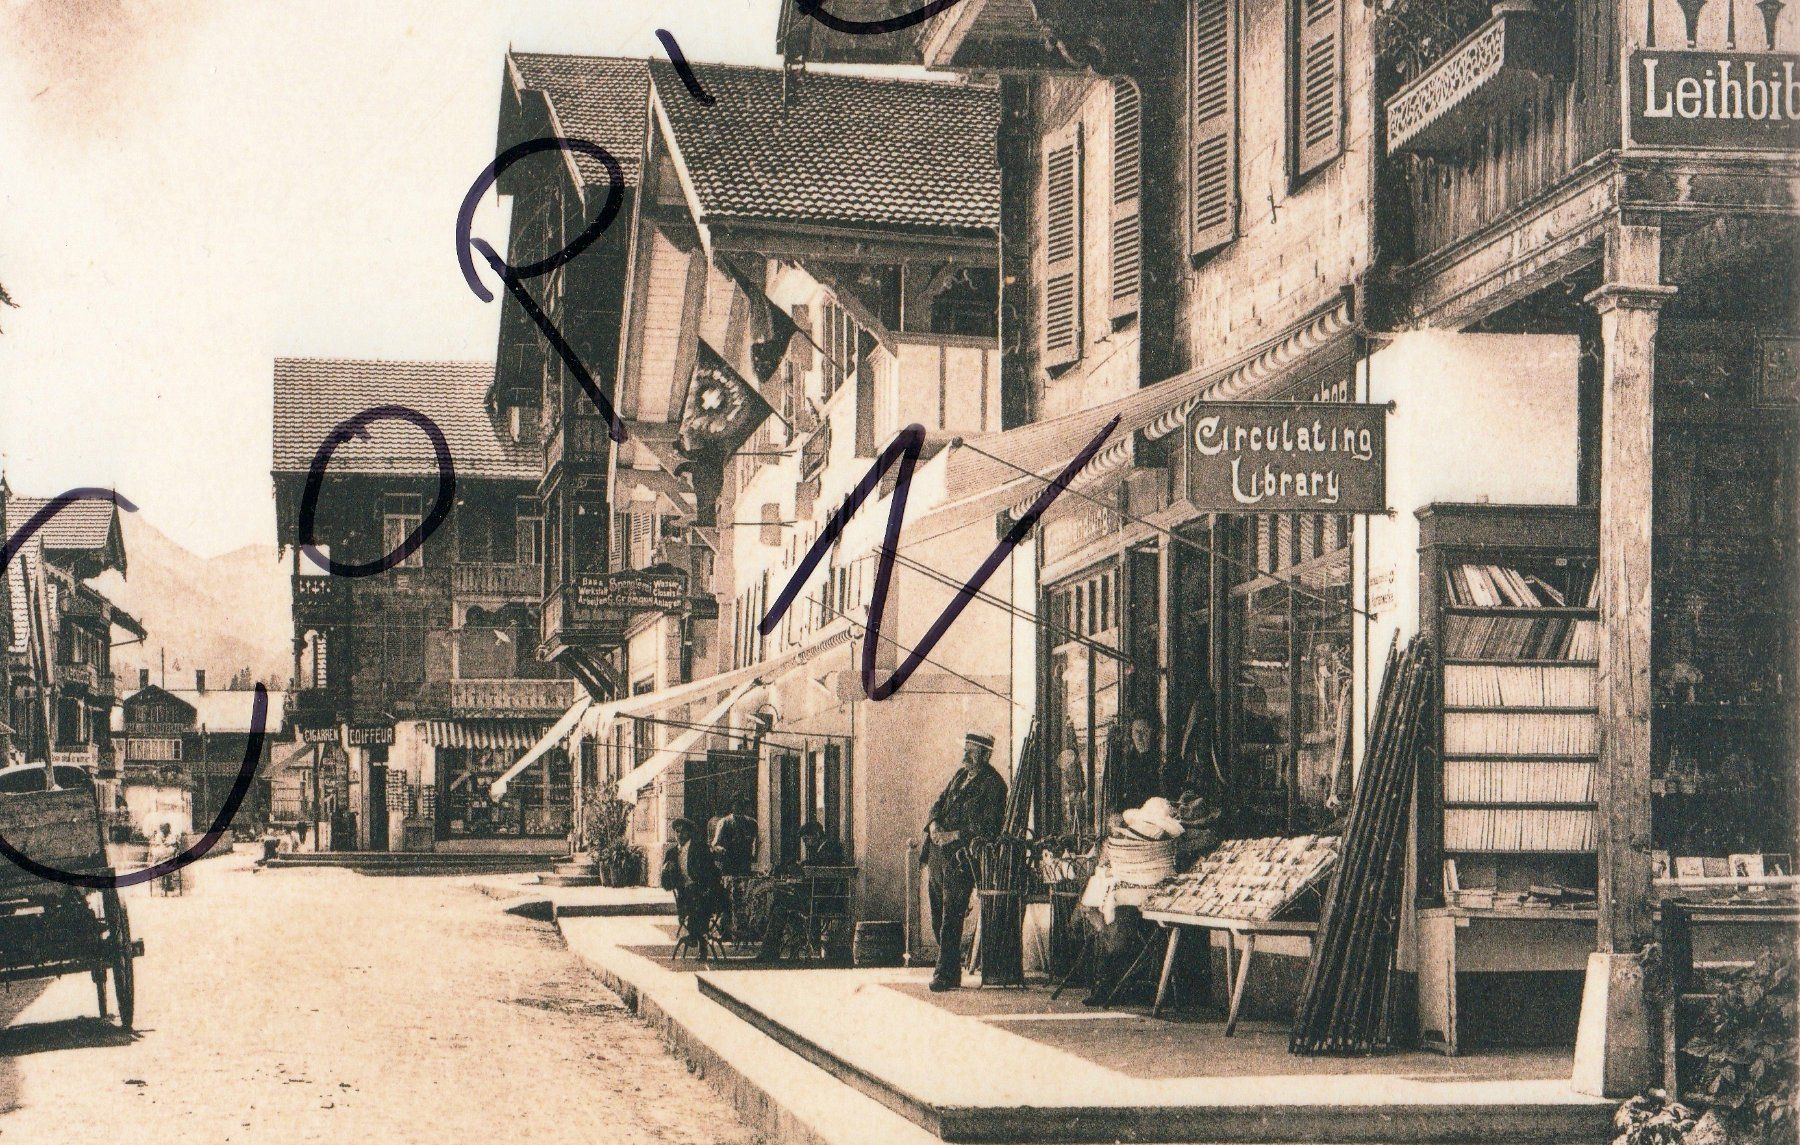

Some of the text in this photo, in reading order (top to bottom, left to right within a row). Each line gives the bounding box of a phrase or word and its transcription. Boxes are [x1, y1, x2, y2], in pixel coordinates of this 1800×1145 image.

[1643, 58, 1800, 121] Leihbib
[1195, 415, 1372, 461] Circulating
[1231, 456, 1339, 504] Library
[305, 728, 339, 742] CIGARREN
[350, 728, 393, 744] COIFFEUR
